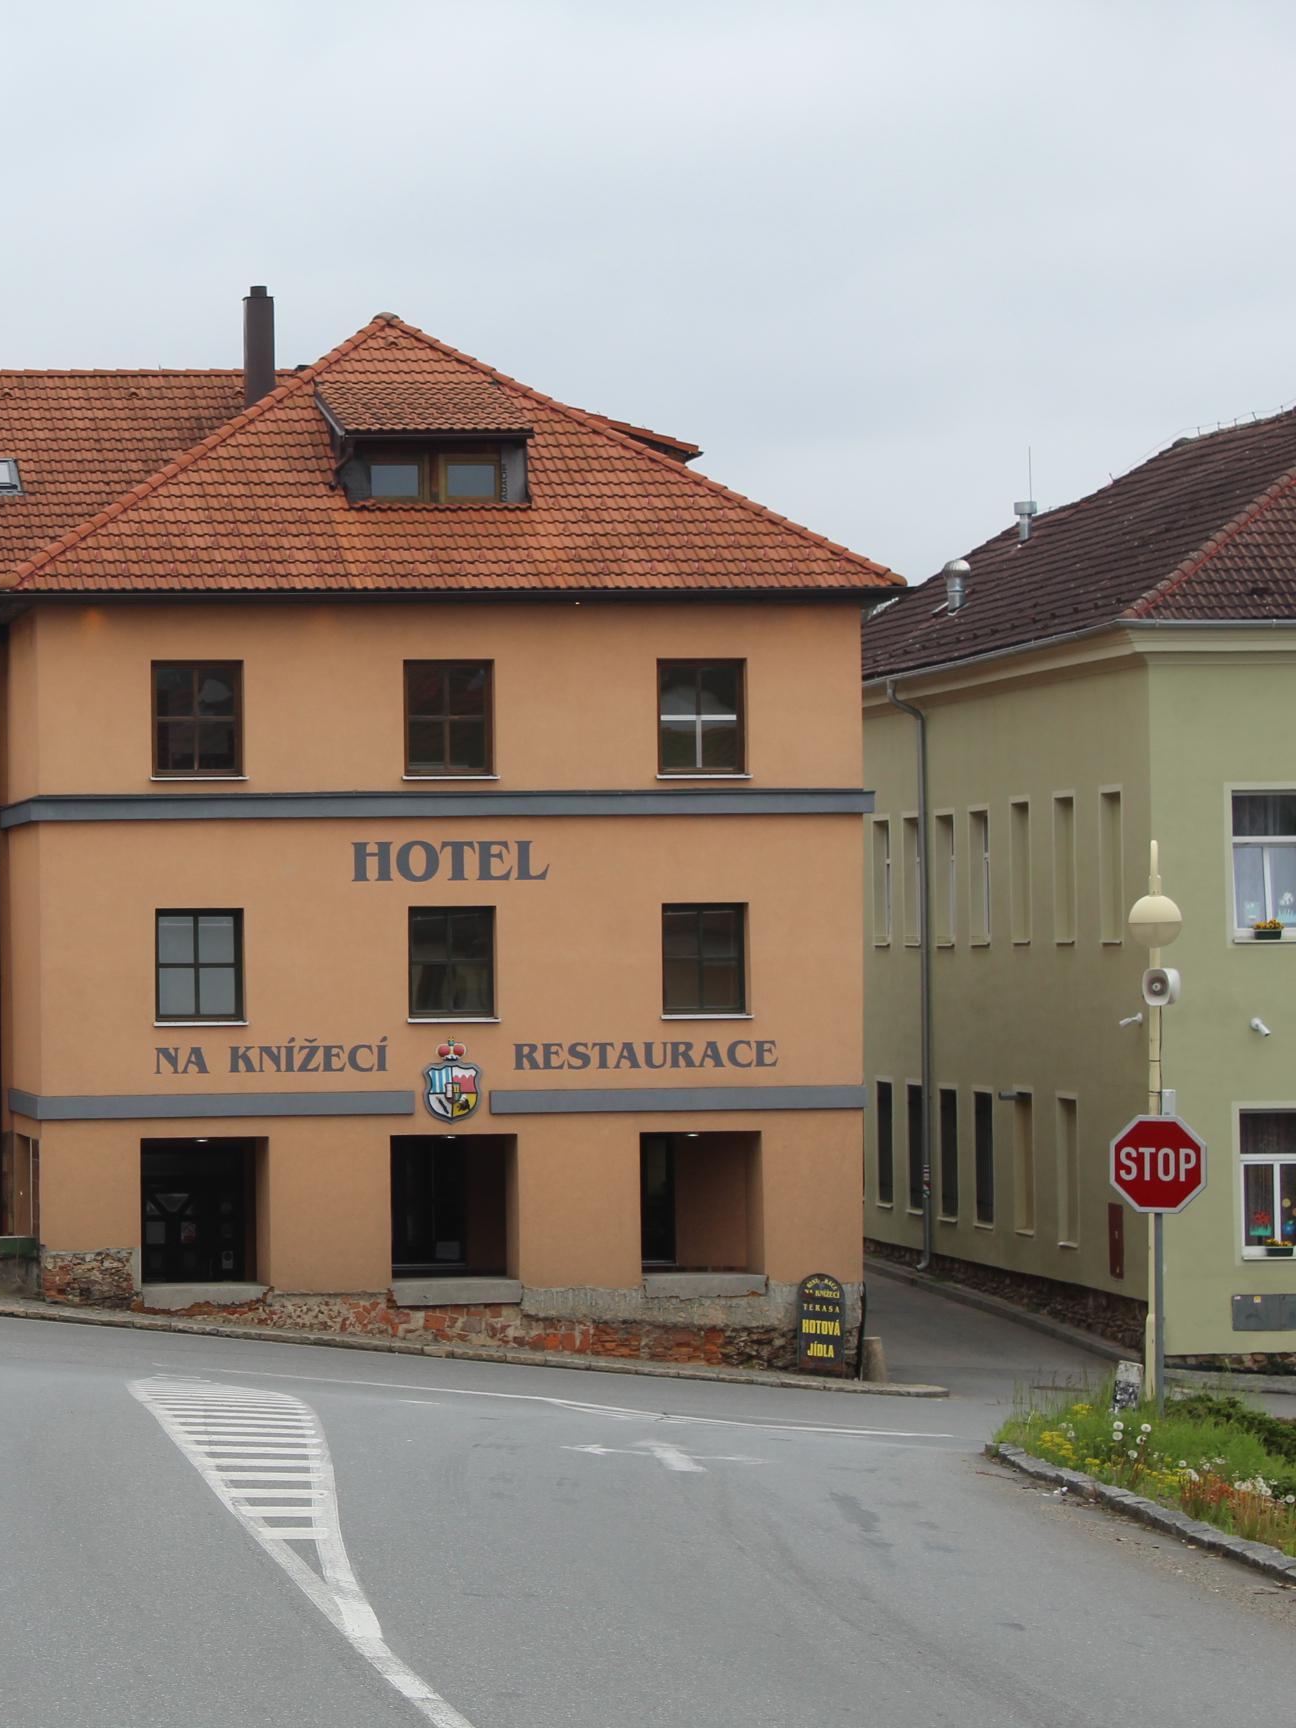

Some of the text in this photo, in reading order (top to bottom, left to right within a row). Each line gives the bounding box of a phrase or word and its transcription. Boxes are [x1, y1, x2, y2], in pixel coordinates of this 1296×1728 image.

[352, 839, 550, 884] HOTEL
[154, 1036, 389, 1075] NA KNÍŽECÍ
[513, 1039, 779, 1071] RESTAURACE
[1119, 1147, 1197, 1182] STOP
[802, 1319, 841, 1336] HOTOVÁ
[807, 1341, 834, 1358] JÍDLA
